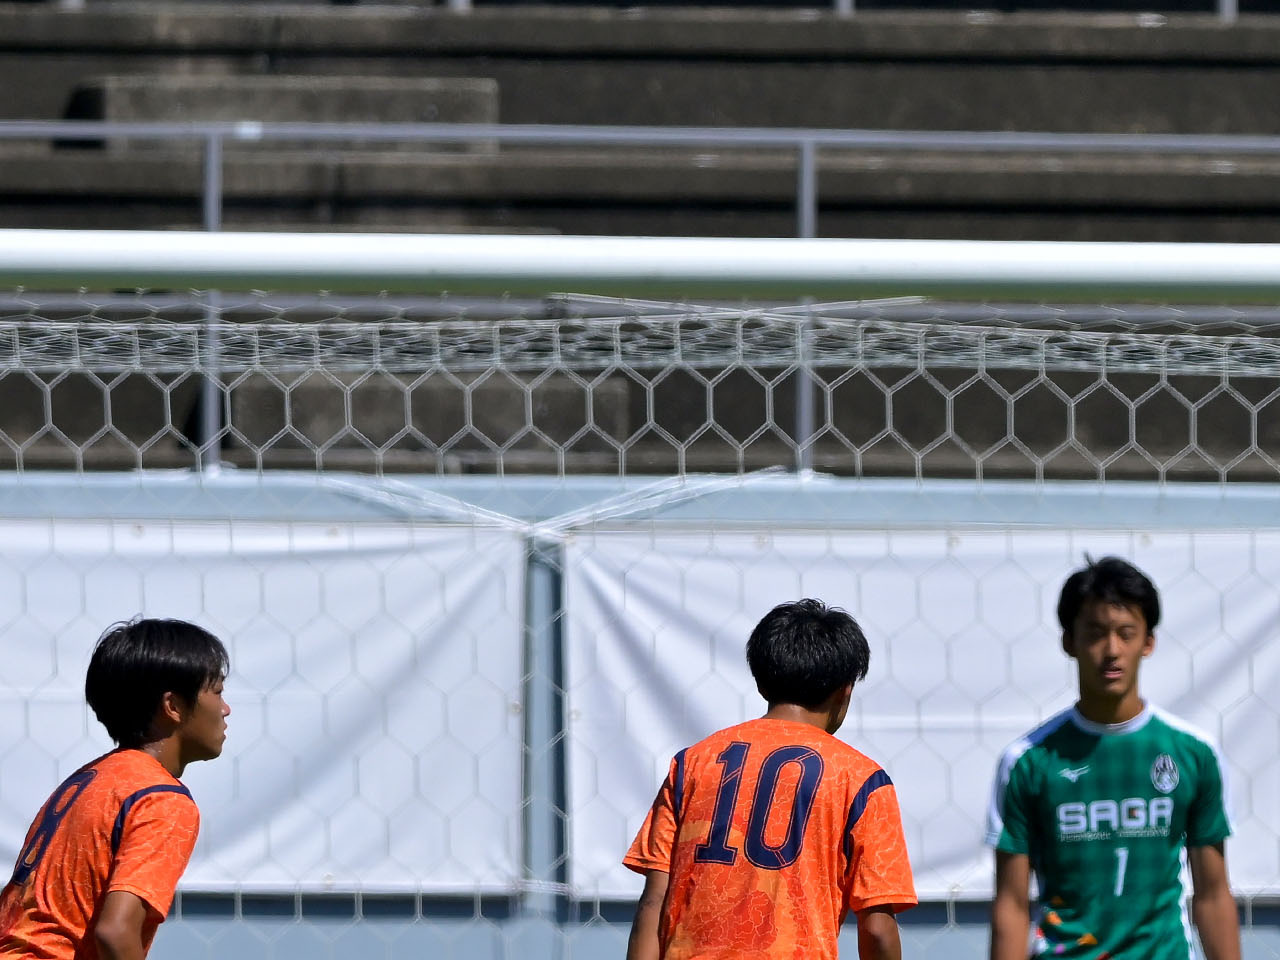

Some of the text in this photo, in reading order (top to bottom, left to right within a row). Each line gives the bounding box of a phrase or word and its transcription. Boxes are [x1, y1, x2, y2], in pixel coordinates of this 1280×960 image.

[694, 741, 824, 870] 10
[1057, 797, 1174, 833] SAGA
[1114, 847, 1128, 896] 1
